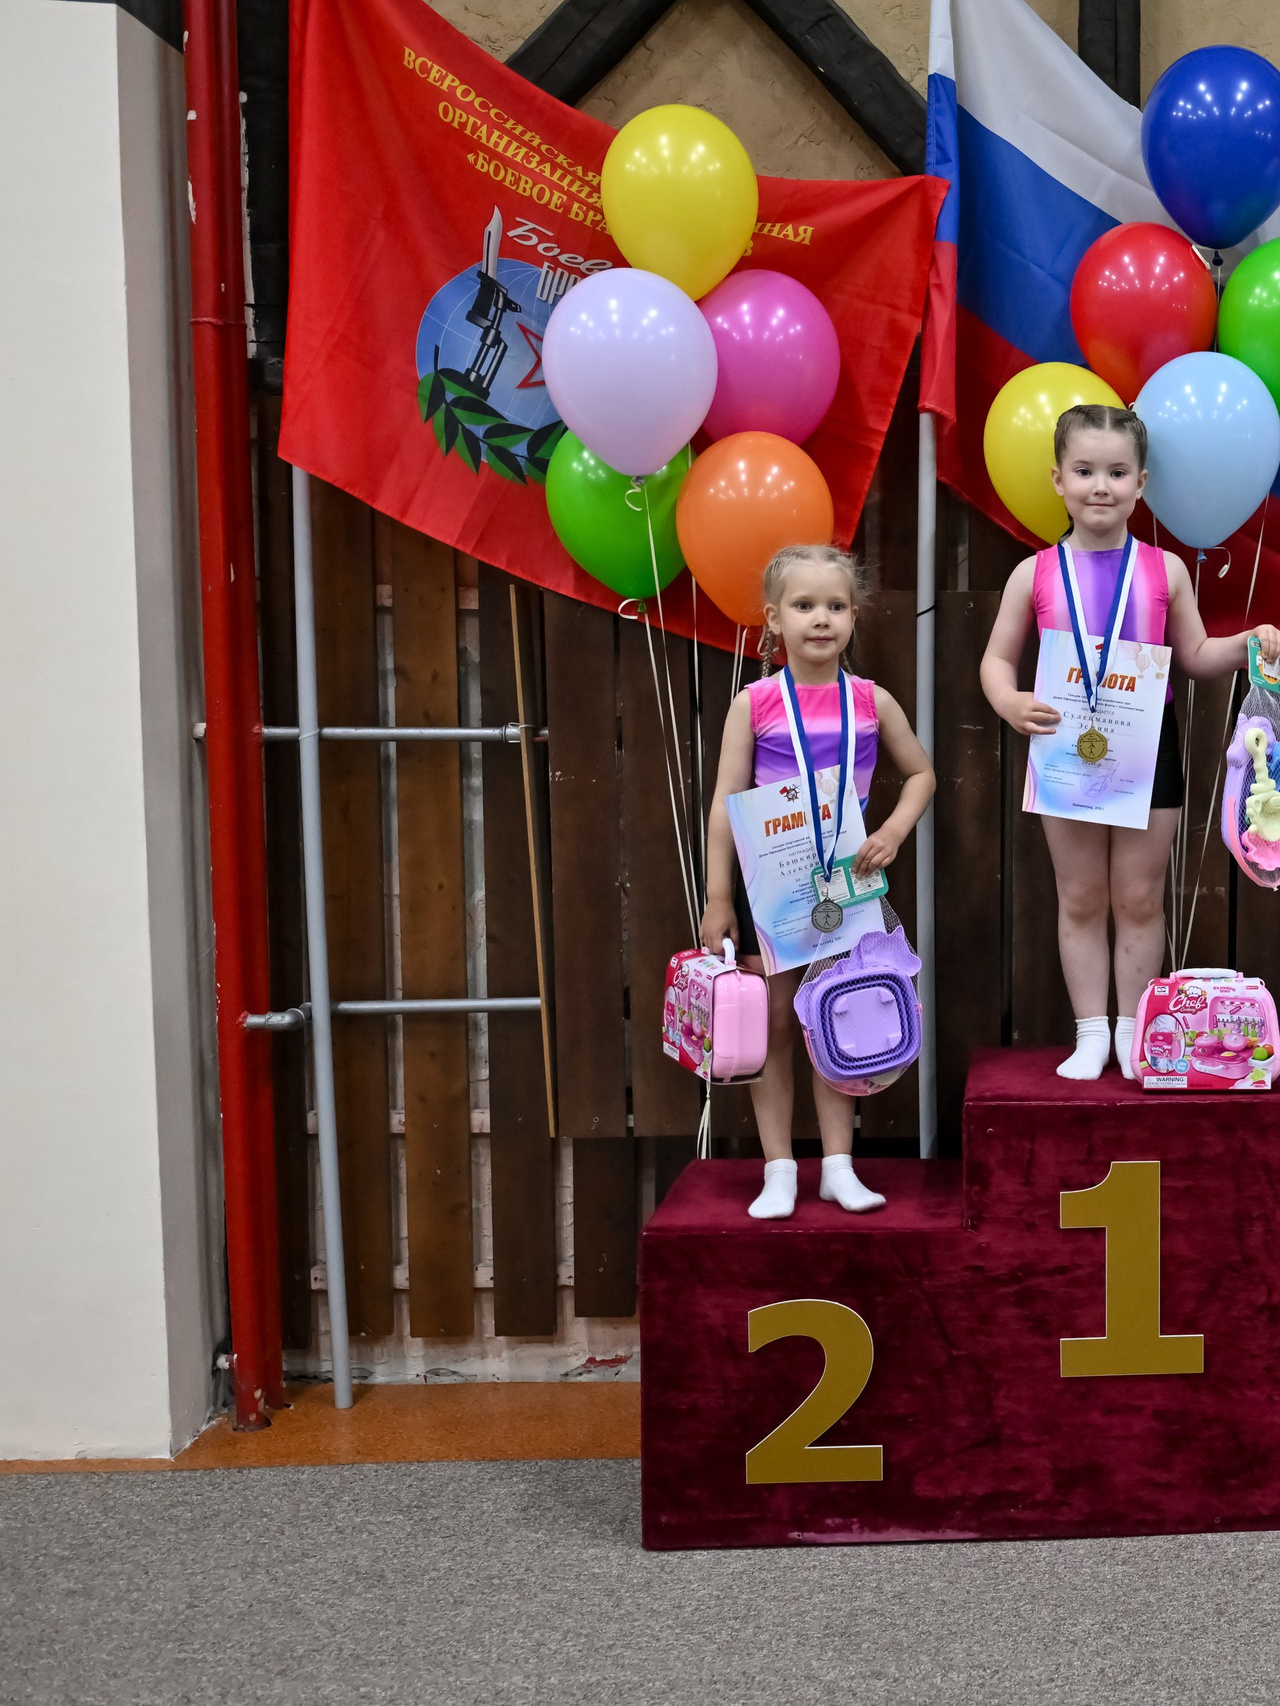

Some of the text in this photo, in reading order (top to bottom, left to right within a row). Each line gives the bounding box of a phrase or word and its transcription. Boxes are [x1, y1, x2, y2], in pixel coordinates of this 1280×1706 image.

[403, 46, 602, 188] ВСЕРОССИЙСКАЯ
[438, 101, 603, 209] ОРГАНИЗАЦИЯ
[466, 150, 568, 213] «БОЕВОЕ
[1169, 995, 1206, 1011] Chef
[1060, 1160, 1206, 1378] 1
[746, 1299, 884, 1484] 2
